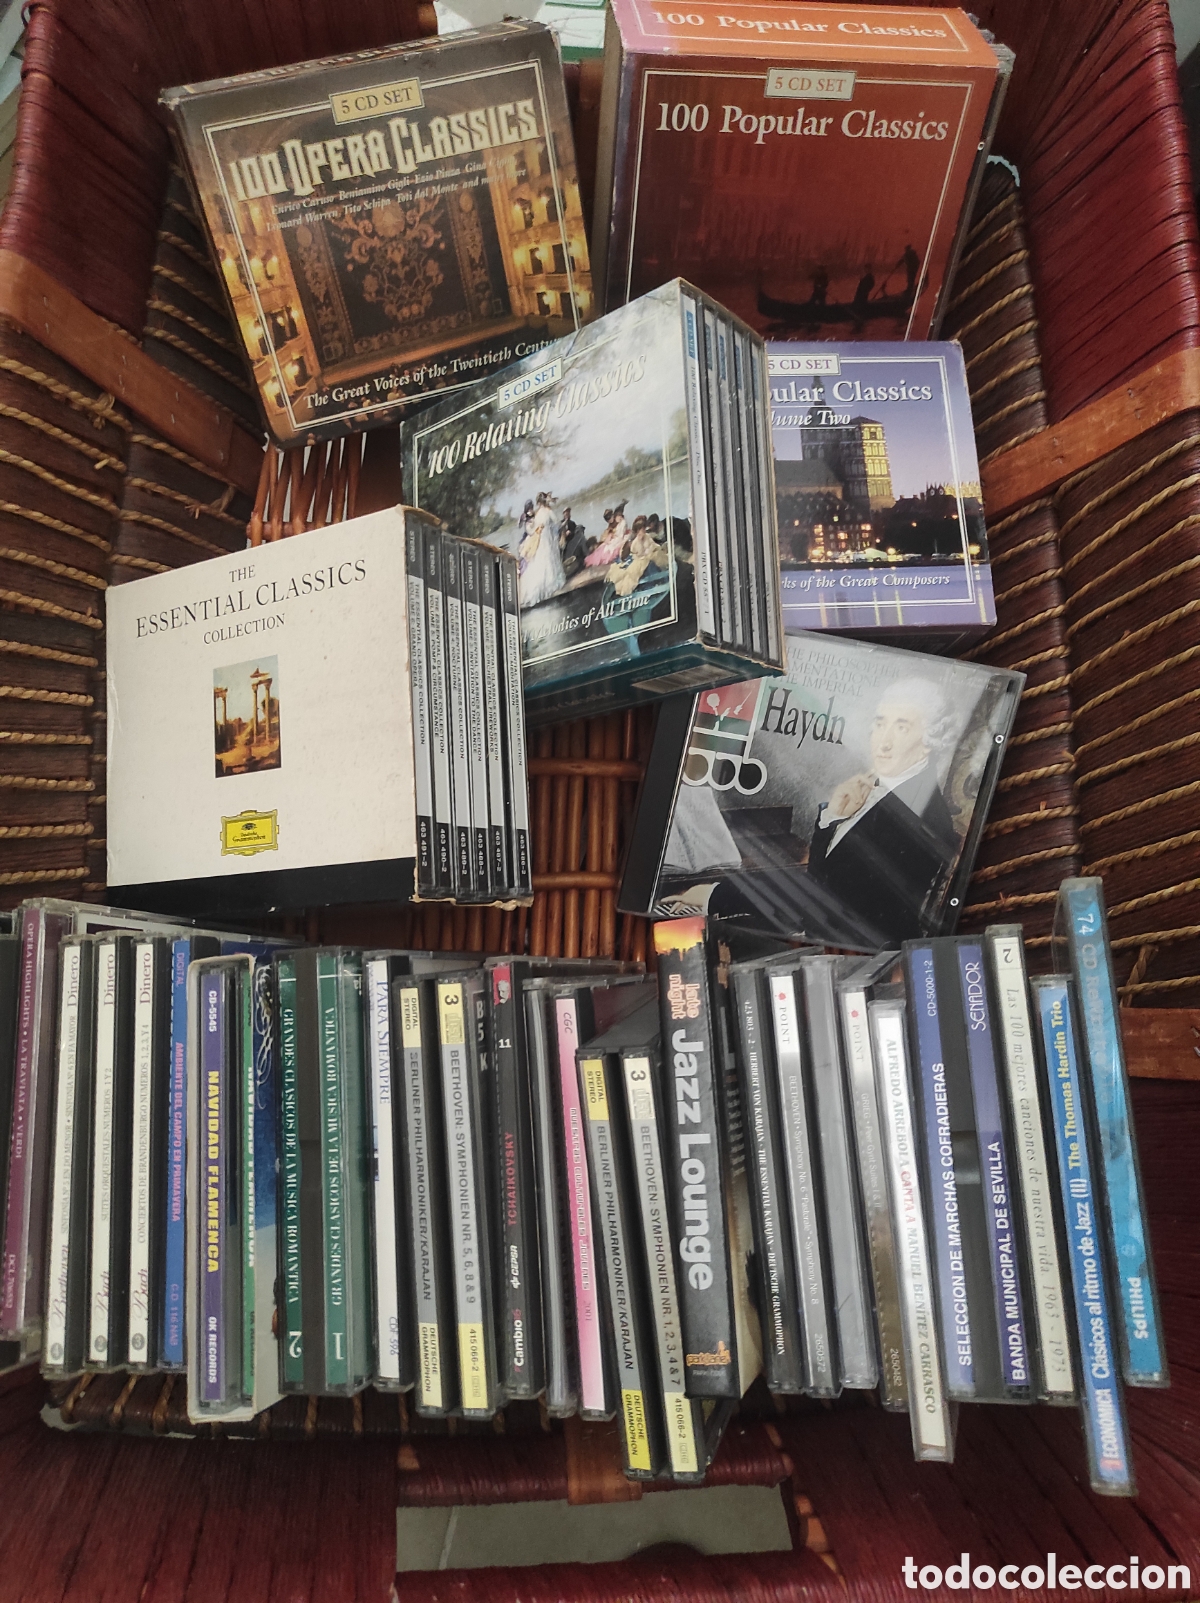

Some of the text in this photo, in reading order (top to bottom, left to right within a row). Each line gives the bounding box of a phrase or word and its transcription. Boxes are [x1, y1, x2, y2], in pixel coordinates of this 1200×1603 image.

[653, 12, 947, 40] 100 Popular Classics
[341, 87, 413, 114] 5 CD SET
[775, 77, 846, 93] 5 CD SET
[656, 102, 949, 147] 100 Popular Classics
[230, 99, 541, 202] 100 OPERA CLASSICS
[304, 393, 328, 409] The
[332, 383, 370, 401] Great
[374, 373, 409, 390] Voices
[414, 367, 428, 386] of
[428, 363, 447, 379] the
[450, 348, 511, 372] Twentieth
[504, 365, 557, 400] 5 CD SET
[768, 360, 832, 370] 5 CD SET
[770, 380, 932, 403] ular Classics
[429, 355, 646, 478] 100 Relaxing Classics
[771, 408, 851, 427] lume Two
[229, 565, 256, 582] THE
[801, 573, 950, 591] of the Great Composers
[136, 560, 366, 638] ESSENTIAL CLASSICS
[582, 607, 595, 628] of
[595, 601, 614, 621] All
[619, 594, 650, 612] Time
[204, 614, 286, 644] COLLECTION
[760, 686, 845, 748] Haydn
[1077, 913, 1095, 934] 74
[175, 953, 185, 986] DIGITAL
[1002, 949, 1014, 964] 2
[22, 961, 32, 1028] HIGHLIGHTS
[66, 955, 80, 1007] Dinero
[103, 953, 116, 1006] Dinero
[140, 952, 152, 1004] Dinero
[668, 974, 686, 1020] night
[923, 960, 937, 1016] CD-5000-1-2
[208, 991, 217, 1032] CD-5545
[444, 995, 459, 1006] 3
[686, 984, 700, 1018] late
[1006, 988, 1021, 1009] Las
[1049, 1001, 1063, 1028] Trio
[376, 981, 392, 1104] PARA SIEMPRE
[563, 1012, 572, 1034] CGC
[778, 1006, 791, 1045] POINT
[1009, 1015, 1025, 1038] 100
[21, 1039, 28, 1053] LA
[499, 1039, 511, 1048] 11
[1053, 1031, 1070, 1078] Hardin
[18, 1055, 27, 1113] TRAVIATA
[586, 1071, 597, 1104] STEREO
[595, 1070, 604, 1102] DIGITAL
[1010, 1043, 1030, 1093] mejores
[450, 1050, 465, 1130] BEETHOVEN:
[1060, 1081, 1078, 1139] Thomas
[172, 1042, 184, 1222] AMBIENTE DEL CAMPO EN PRIMAVERA
[1019, 1098, 1040, 1162] canciones
[207, 1071, 219, 1273] NAVIDAD FLAMENCA
[282, 1009, 299, 1303] GRANDES CLASICOS DE LA MUSICA ROMANTICA
[671, 1028, 714, 1290] Jazz Lounge
[1028, 1167, 1042, 1183] de
[1067, 1142, 1082, 1169] The
[455, 1133, 471, 1220] SYMPHONIEN
[504, 1132, 517, 1225] TCHAIKOVSKY
[748, 1052, 786, 1356] HERBERT VON KARAJAN THE ESSENTIAL KARAJAN DEUTSCHE GRAMMOPHON
[932, 1062, 972, 1366] SELECCION DE MARCHAS COFRADIERAS
[1030, 1188, 1049, 1240] nuestra
[1073, 1202, 1094, 1236] Jazz
[460, 1223, 472, 1244] NR.
[885, 1038, 937, 1414] ALFREDO ARREBOLA CANTA A MANUEL BENÍTEZ CARRASCO
[462, 1248, 473, 1258] 5,
[463, 1261, 474, 1271] 6,
[510, 1245, 519, 1275] CEPSA
[596, 1125, 634, 1370] BERLINER PHILHARMONIKER/KARAJAN
[987, 1142, 1026, 1380] BANDA MUNICIPAL DE SEVILLA
[1076, 1238, 1095, 1258] de
[52, 1244, 69, 1329] Beethoven
[95, 1270, 111, 1322] Bach
[132, 1268, 149, 1321] Bach
[465, 1295, 476, 1304] 9
[1079, 1260, 1100, 1300] ritmo
[1042, 1285, 1059, 1319] 1963
[1084, 1300, 1102, 1316] al
[1127, 1276, 1150, 1340] PHILIPS
[208, 1316, 216, 1383] OK RECORDS
[288, 1331, 302, 1358] 2
[389, 1338, 398, 1355] 596
[470, 1345, 478, 1372] 066-2
[814, 1333, 826, 1373] 2650572
[1048, 1339, 1065, 1374] 1973
[1086, 1318, 1109, 1380] Clásicos
[890, 1348, 903, 1387] 2650482
[625, 1394, 638, 1456] GRAMMOPHON
[633, 1395, 645, 1440] DEUTSCHE
